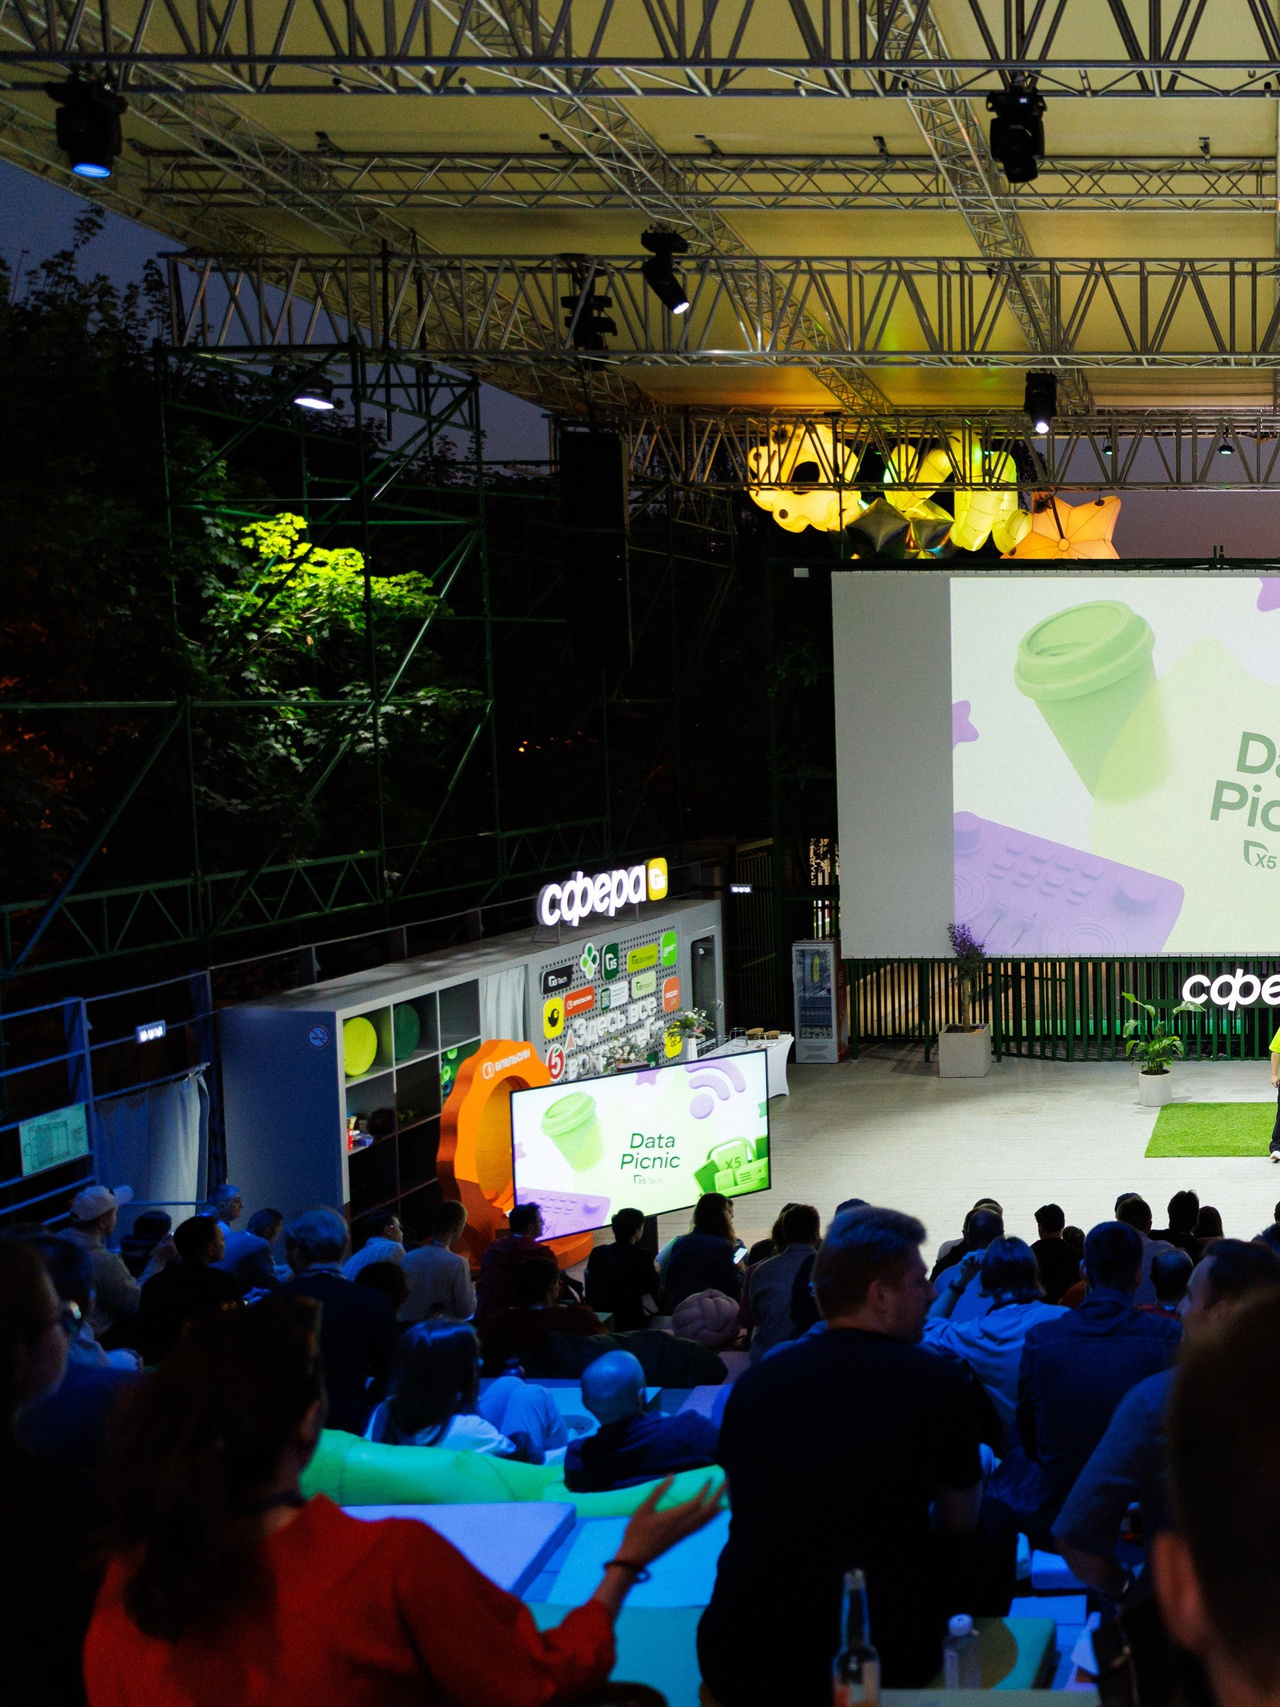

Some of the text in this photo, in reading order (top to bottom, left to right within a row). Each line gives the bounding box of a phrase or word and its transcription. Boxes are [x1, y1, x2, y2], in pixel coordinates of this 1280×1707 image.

[1254, 852, 1277, 869] X5
[540, 864, 646, 927] сфера
[573, 997, 657, 1046] Здесь все
[630, 1132, 675, 1149] Data
[620, 1151, 680, 1170] Picnic
[725, 1156, 742, 1170] X5
